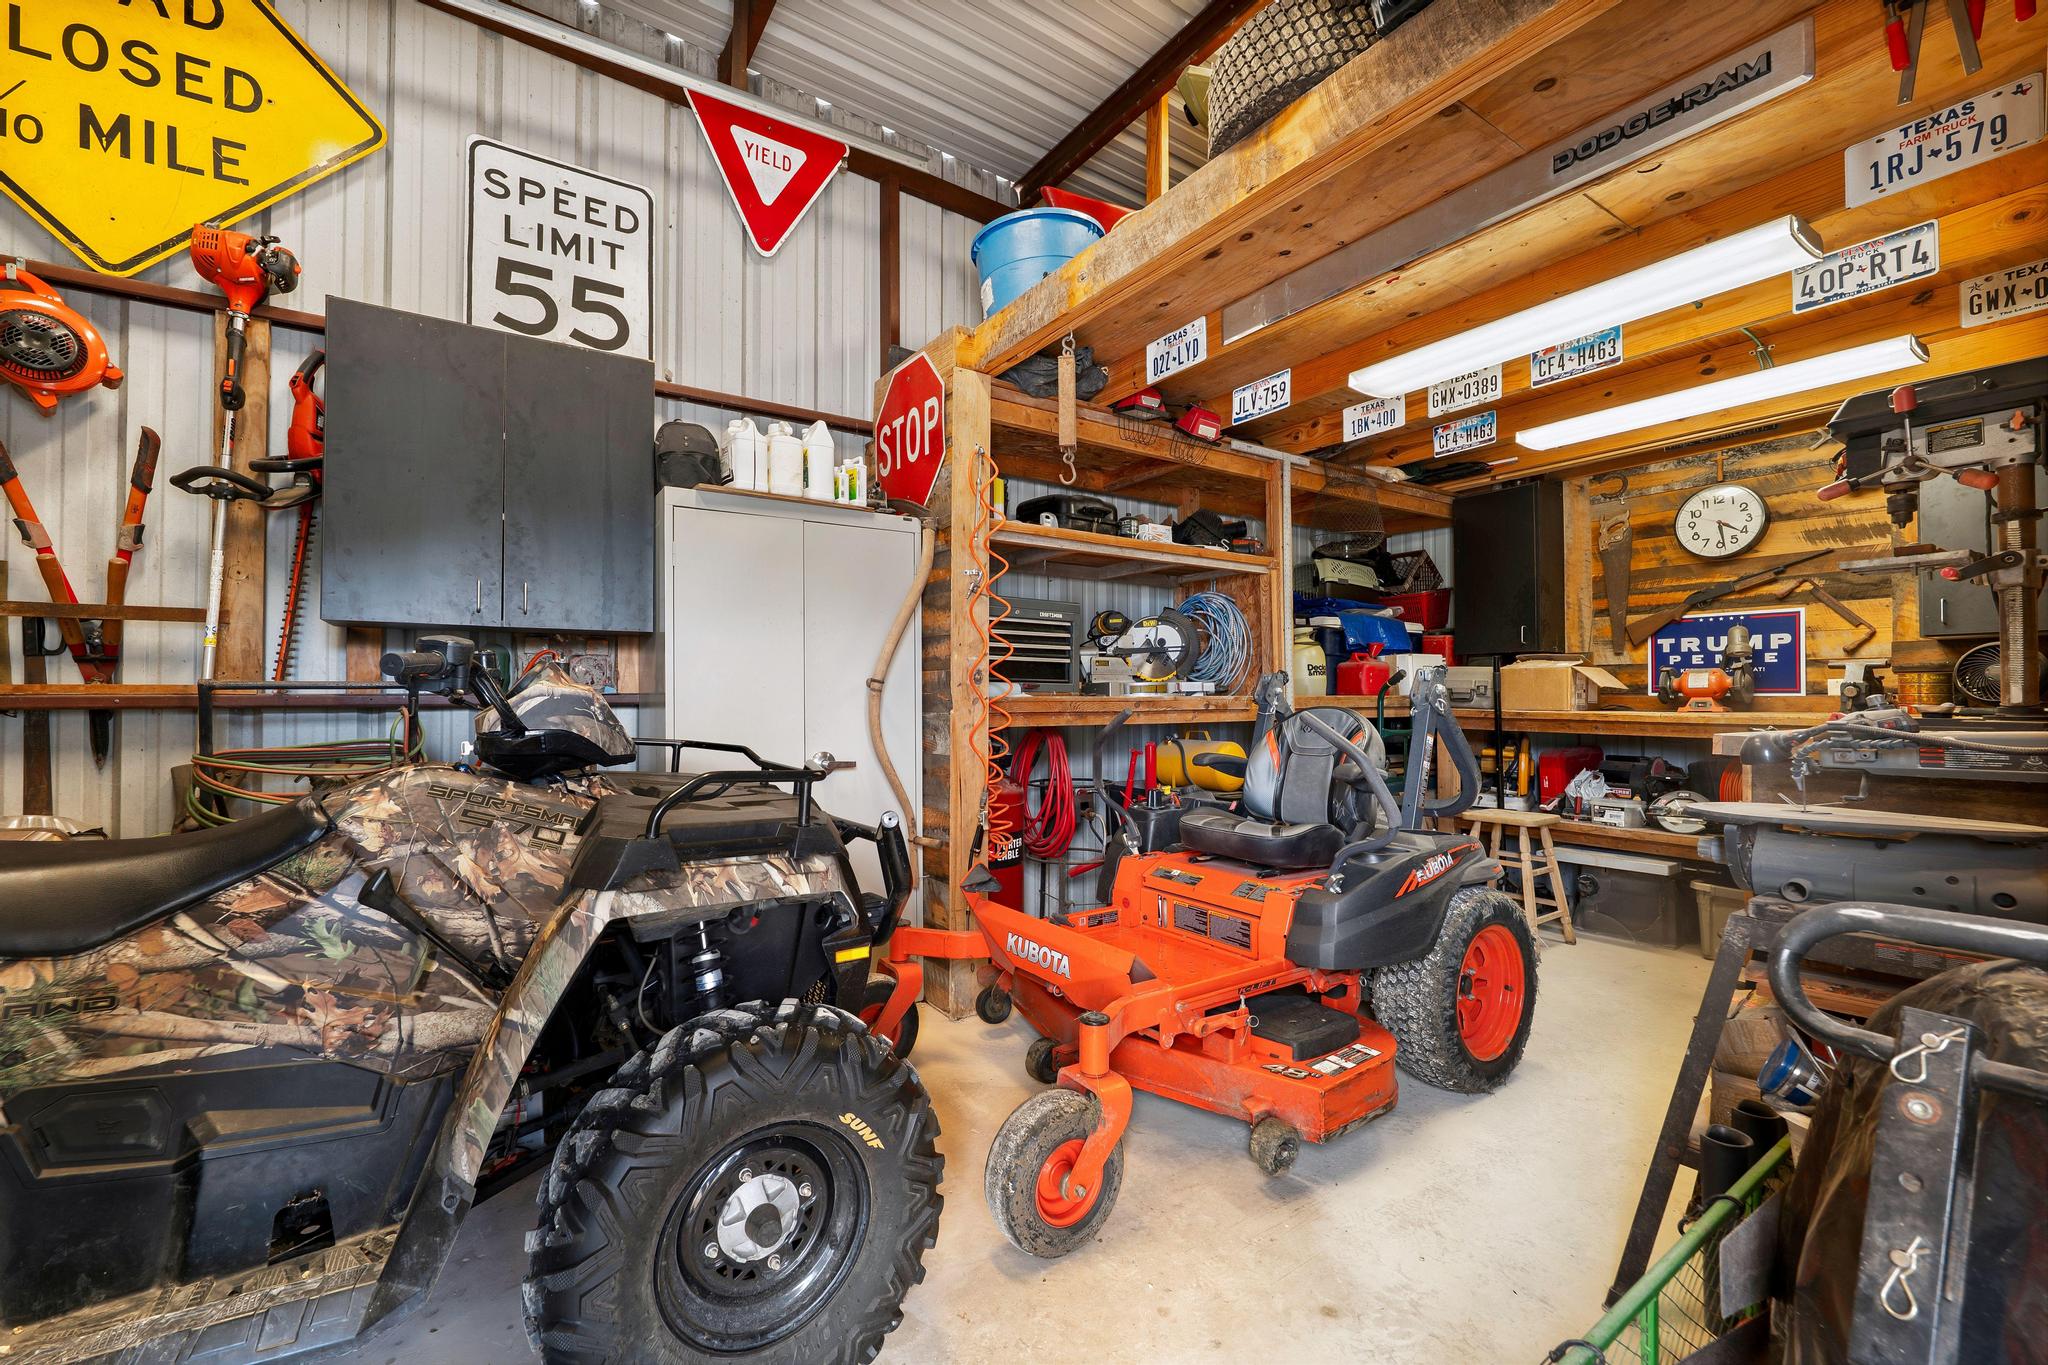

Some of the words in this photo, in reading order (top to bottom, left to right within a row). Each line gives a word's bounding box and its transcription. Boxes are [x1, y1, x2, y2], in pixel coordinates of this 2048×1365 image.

[8, 4, 263, 113] LOSED
[1553, 98, 1675, 174] DODGE
[1682, 50, 1772, 113] RAM
[1899, 101, 1976, 140] TEXAS
[1899, 132, 1932, 150] FARM
[1934, 113, 1977, 136] TRUCK
[79, 103, 249, 186] MILE
[744, 140, 792, 172] YIELD
[483, 168, 639, 234] SPEED
[504, 214, 625, 270] LIMIT
[1840, 239, 1886, 259] TEXAS
[1844, 247, 1881, 263] TRUCK
[2004, 261, 2048, 281] TEXA
[492, 256, 630, 351] 55
[1163, 328, 1188, 347] TEXAS
[1450, 370, 1479, 384] TEXAS
[1361, 399, 1386, 412] TEXAS
[879, 397, 939, 477] STOP
[1702, 499, 1709, 509] 11
[1713, 495, 1725, 505] 12
[1731, 496, 1735, 505] 1
[1739, 502, 1749, 512] 2
[1689, 509, 1702, 519] 10
[1745, 513, 1753, 522] 3
[1688, 521, 1697, 530] 9
[1740, 525, 1749, 534] 4
[1692, 531, 1701, 541] 8
[1702, 538, 1710, 548] 7
[1716, 540, 1725, 549] 6
[1730, 534, 1739, 544] 5
[1669, 652, 1778, 665] PENE
[458, 809, 567, 846] 570
[1006, 931, 1071, 979] KUBOTA
[838, 1112, 885, 1150] SUNF
